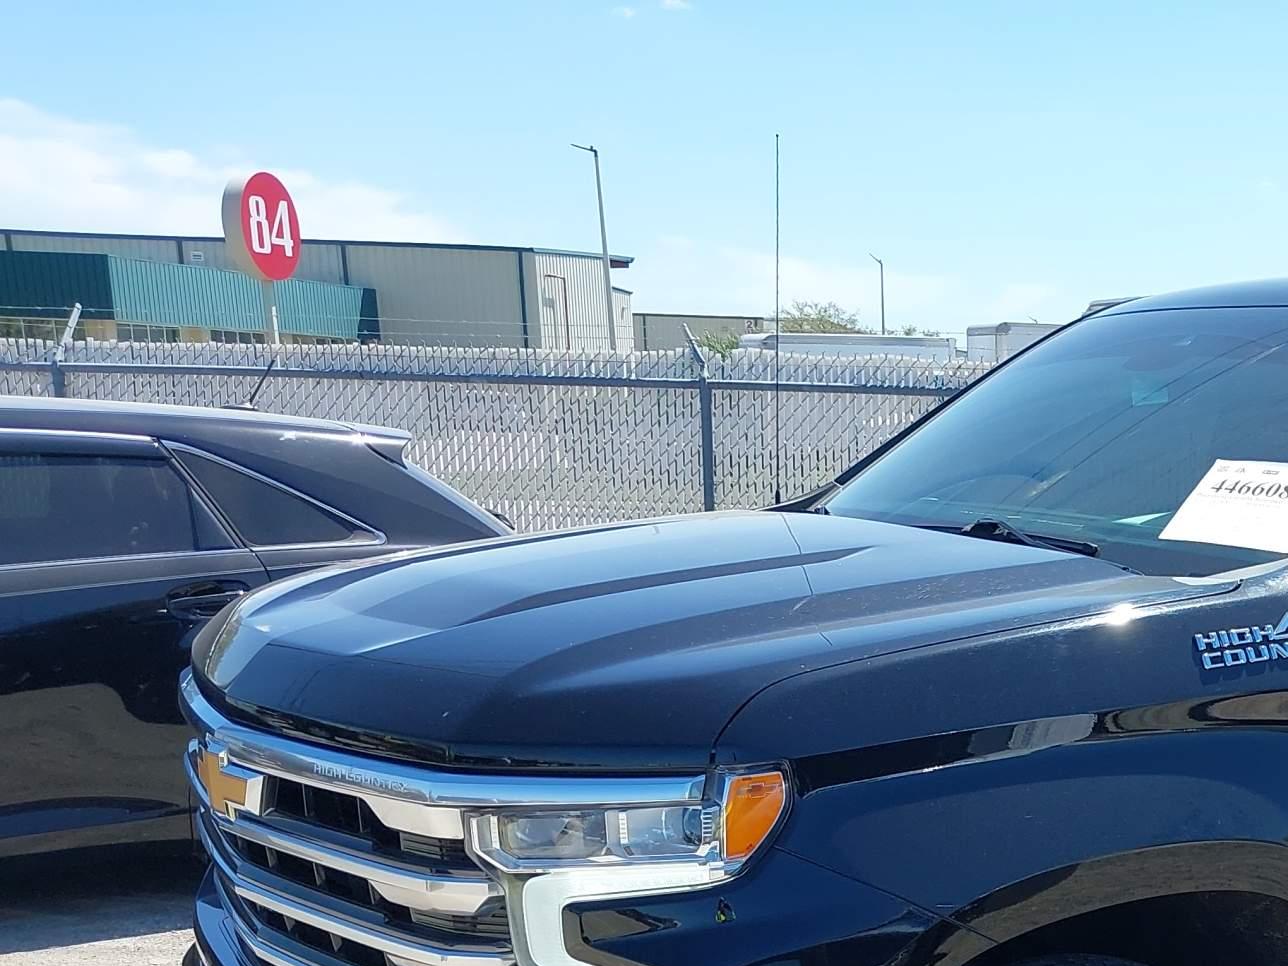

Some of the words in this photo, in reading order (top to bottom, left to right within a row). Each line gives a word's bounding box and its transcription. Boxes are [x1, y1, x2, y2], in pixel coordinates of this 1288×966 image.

[248, 195, 294, 257] 84
[1195, 624, 1275, 651] HIGH
[313, 763, 342, 779] HIGH
